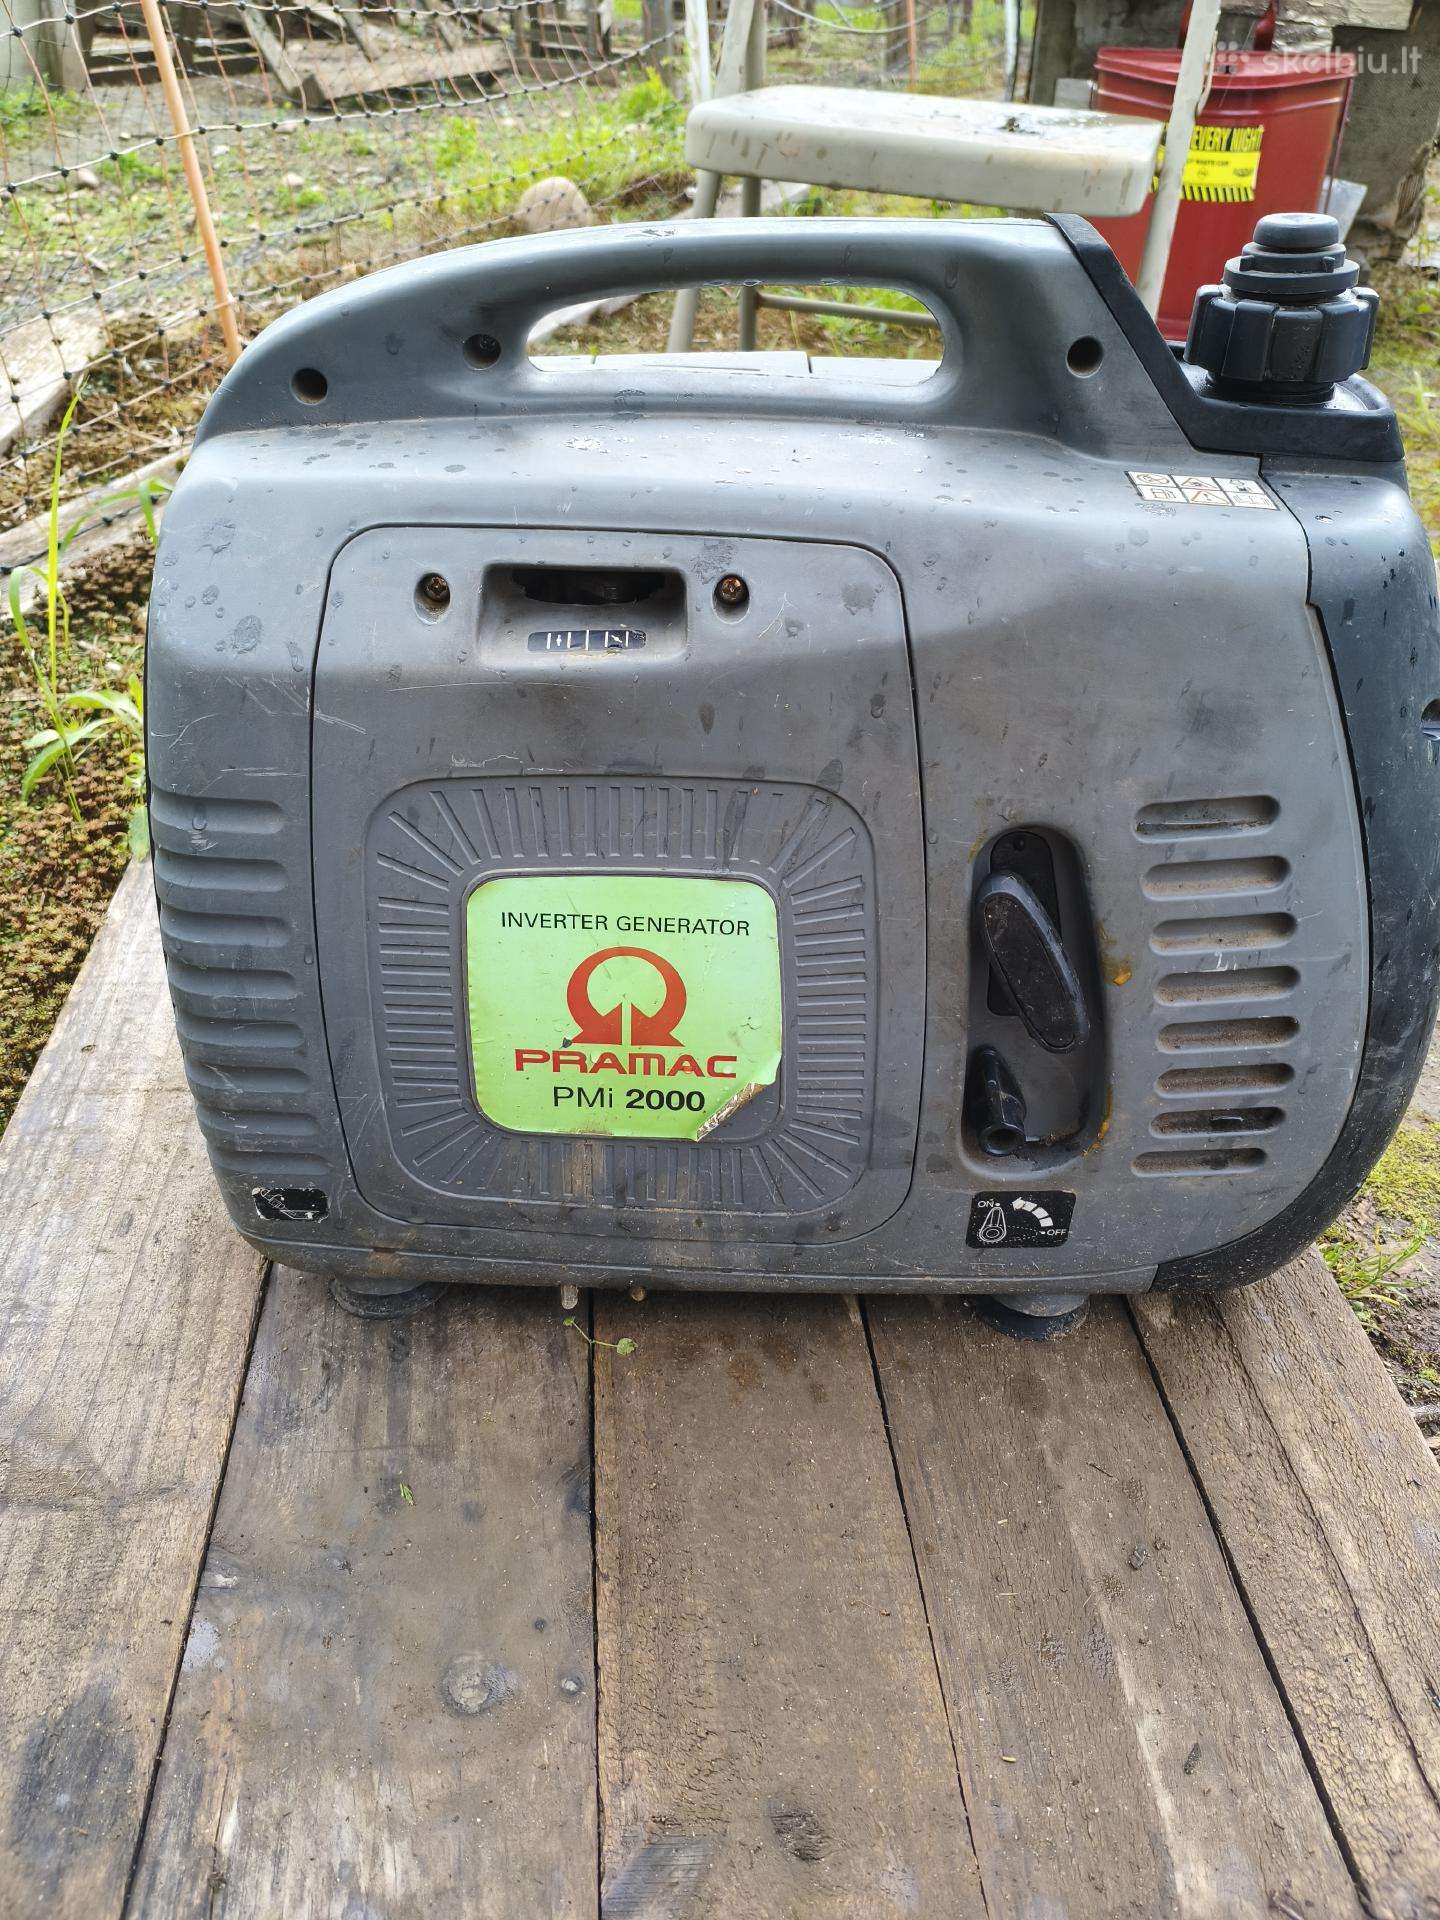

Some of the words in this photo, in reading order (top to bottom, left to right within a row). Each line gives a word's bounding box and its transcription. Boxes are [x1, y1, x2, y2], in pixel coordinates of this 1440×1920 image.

[1191, 126, 1234, 151] EVERY
[1230, 127, 1263, 152] NIGHT
[501, 912, 608, 931] INVERTER
[616, 915, 750, 936] GENERATOR
[515, 1048, 738, 1079] PRAMAC
[553, 1086, 613, 1109] PMi
[625, 1089, 706, 1112] 2000
[977, 1200, 995, 1208] ON
